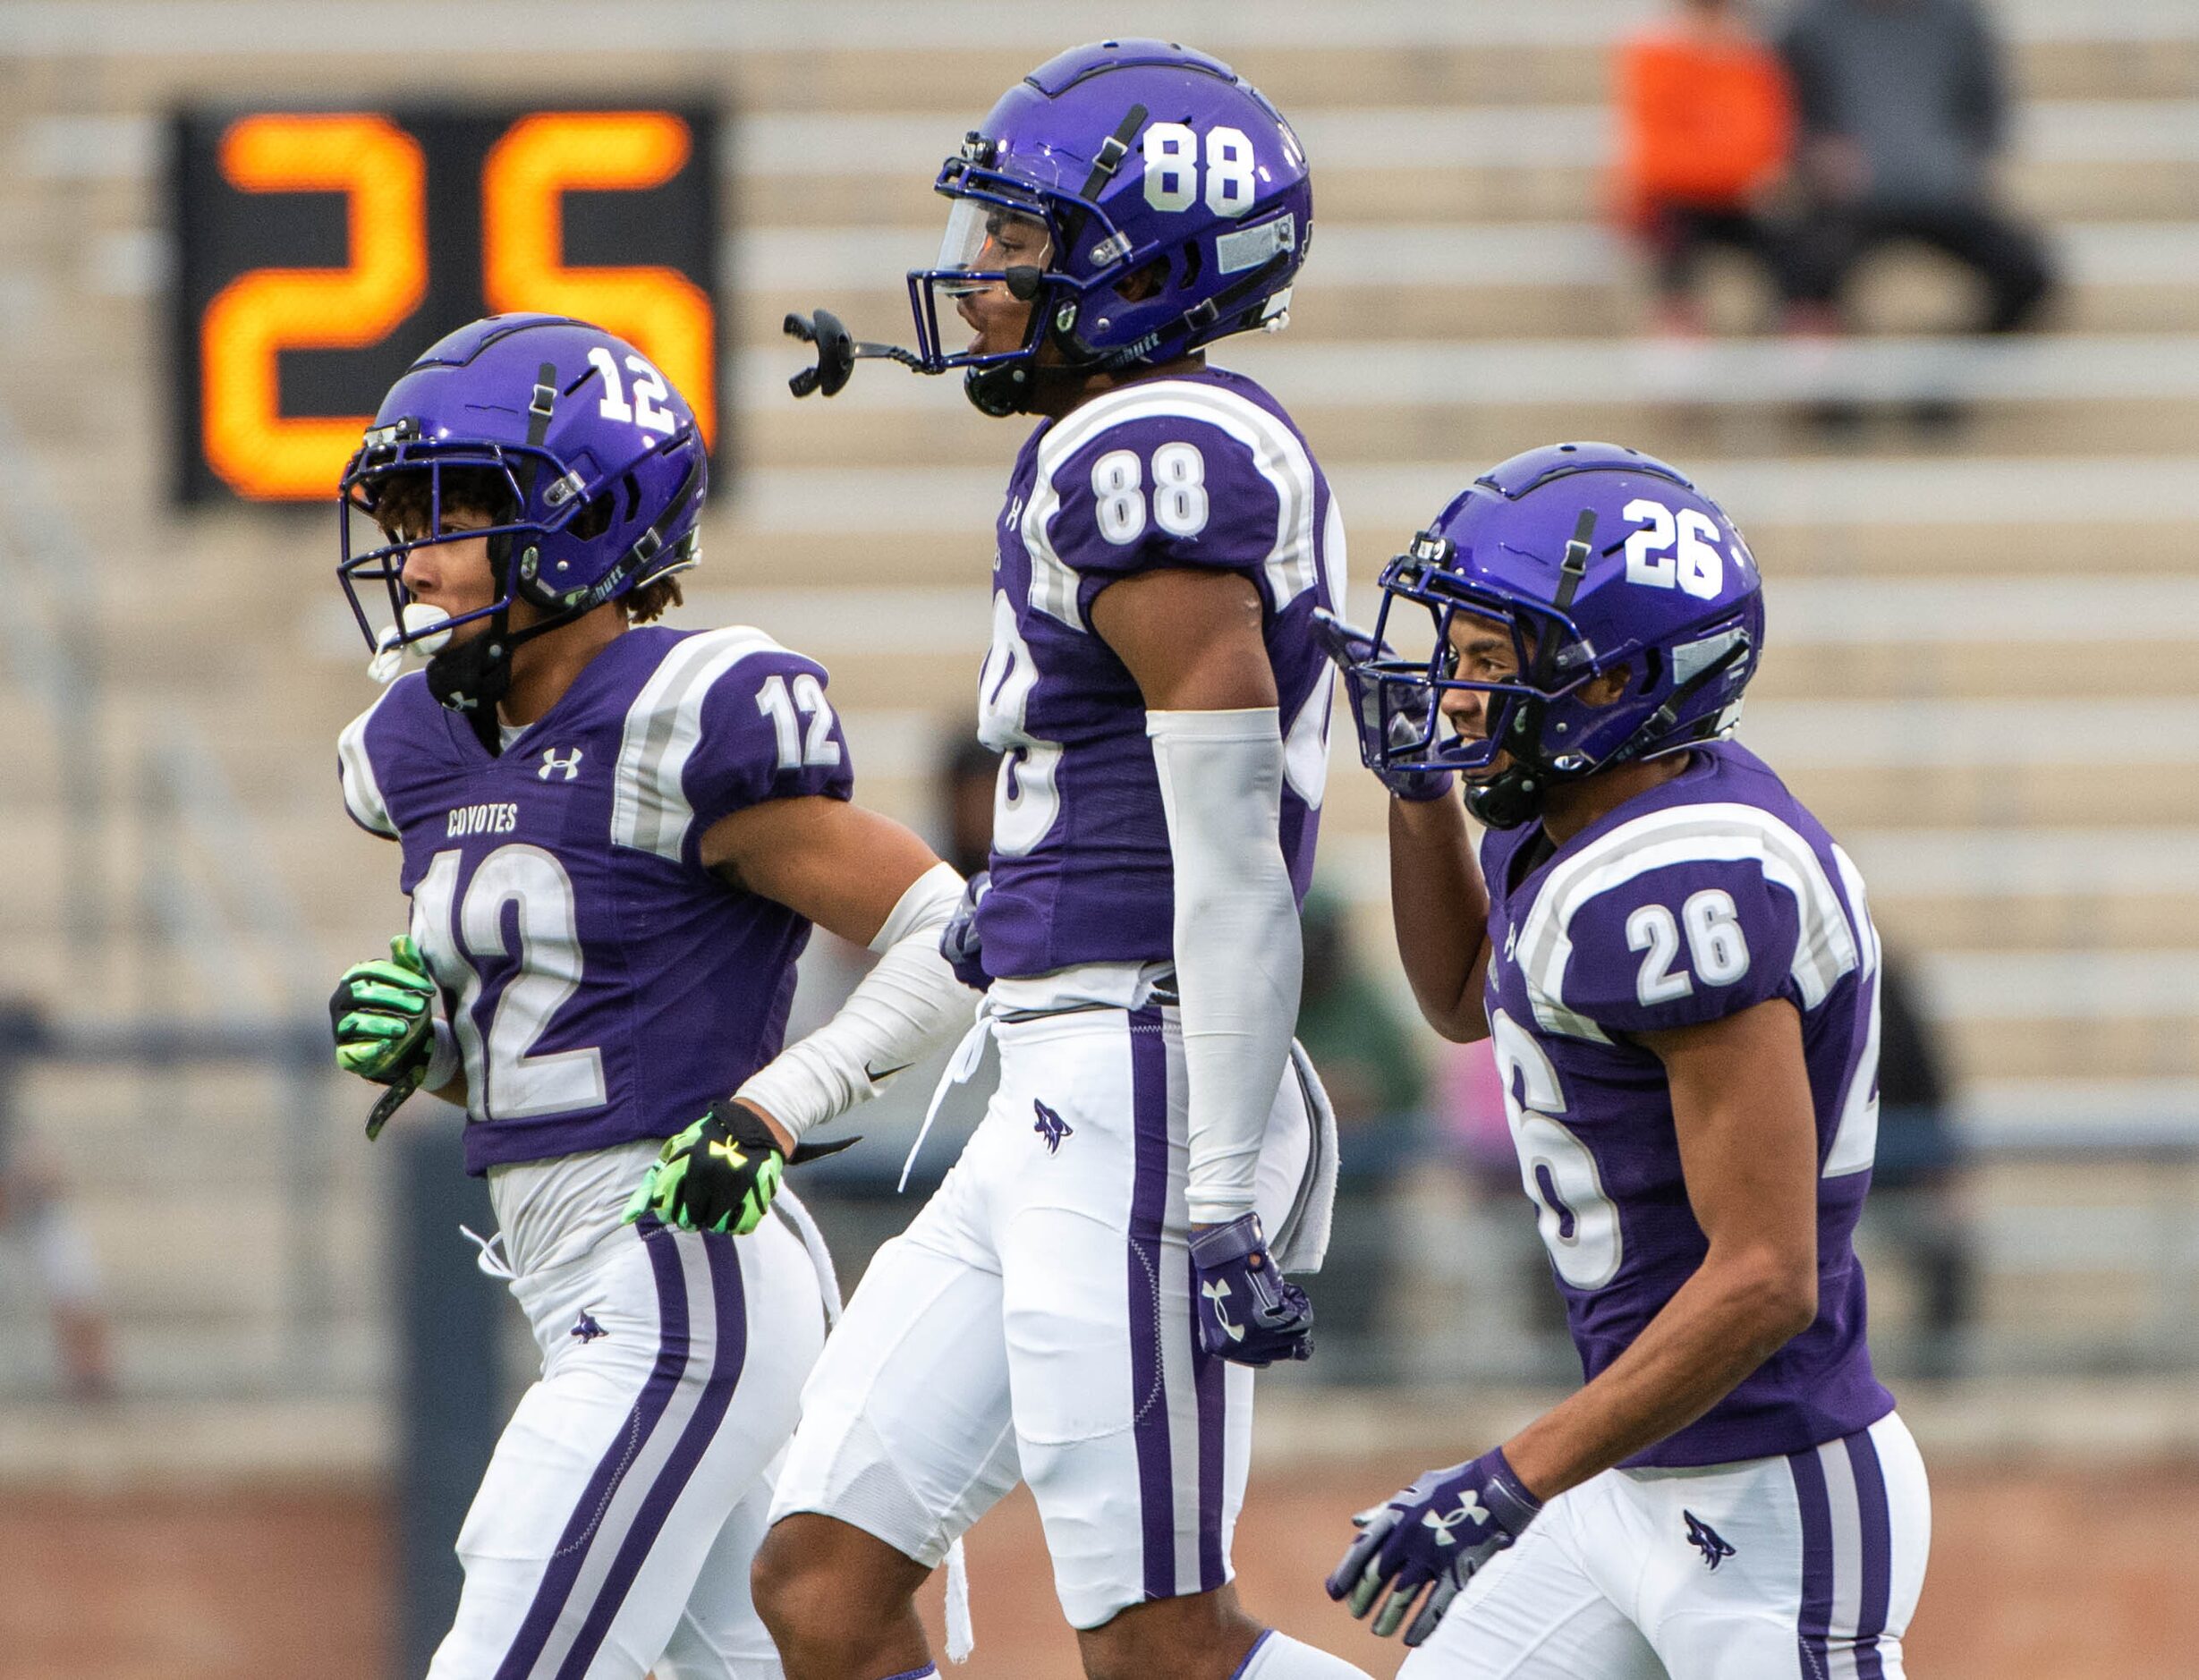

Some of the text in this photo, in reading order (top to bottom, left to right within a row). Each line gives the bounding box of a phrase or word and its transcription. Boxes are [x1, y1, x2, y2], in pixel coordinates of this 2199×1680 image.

[1142, 123, 1255, 218] 88
[201, 110, 717, 501] 25
[588, 347, 675, 435] 12
[1091, 441, 1209, 545] 88
[1623, 498, 1723, 600] 26
[755, 674, 841, 770] 12
[447, 803, 517, 837] COYOTES
[411, 843, 607, 1123] 12
[1625, 889, 1751, 1007] 26
